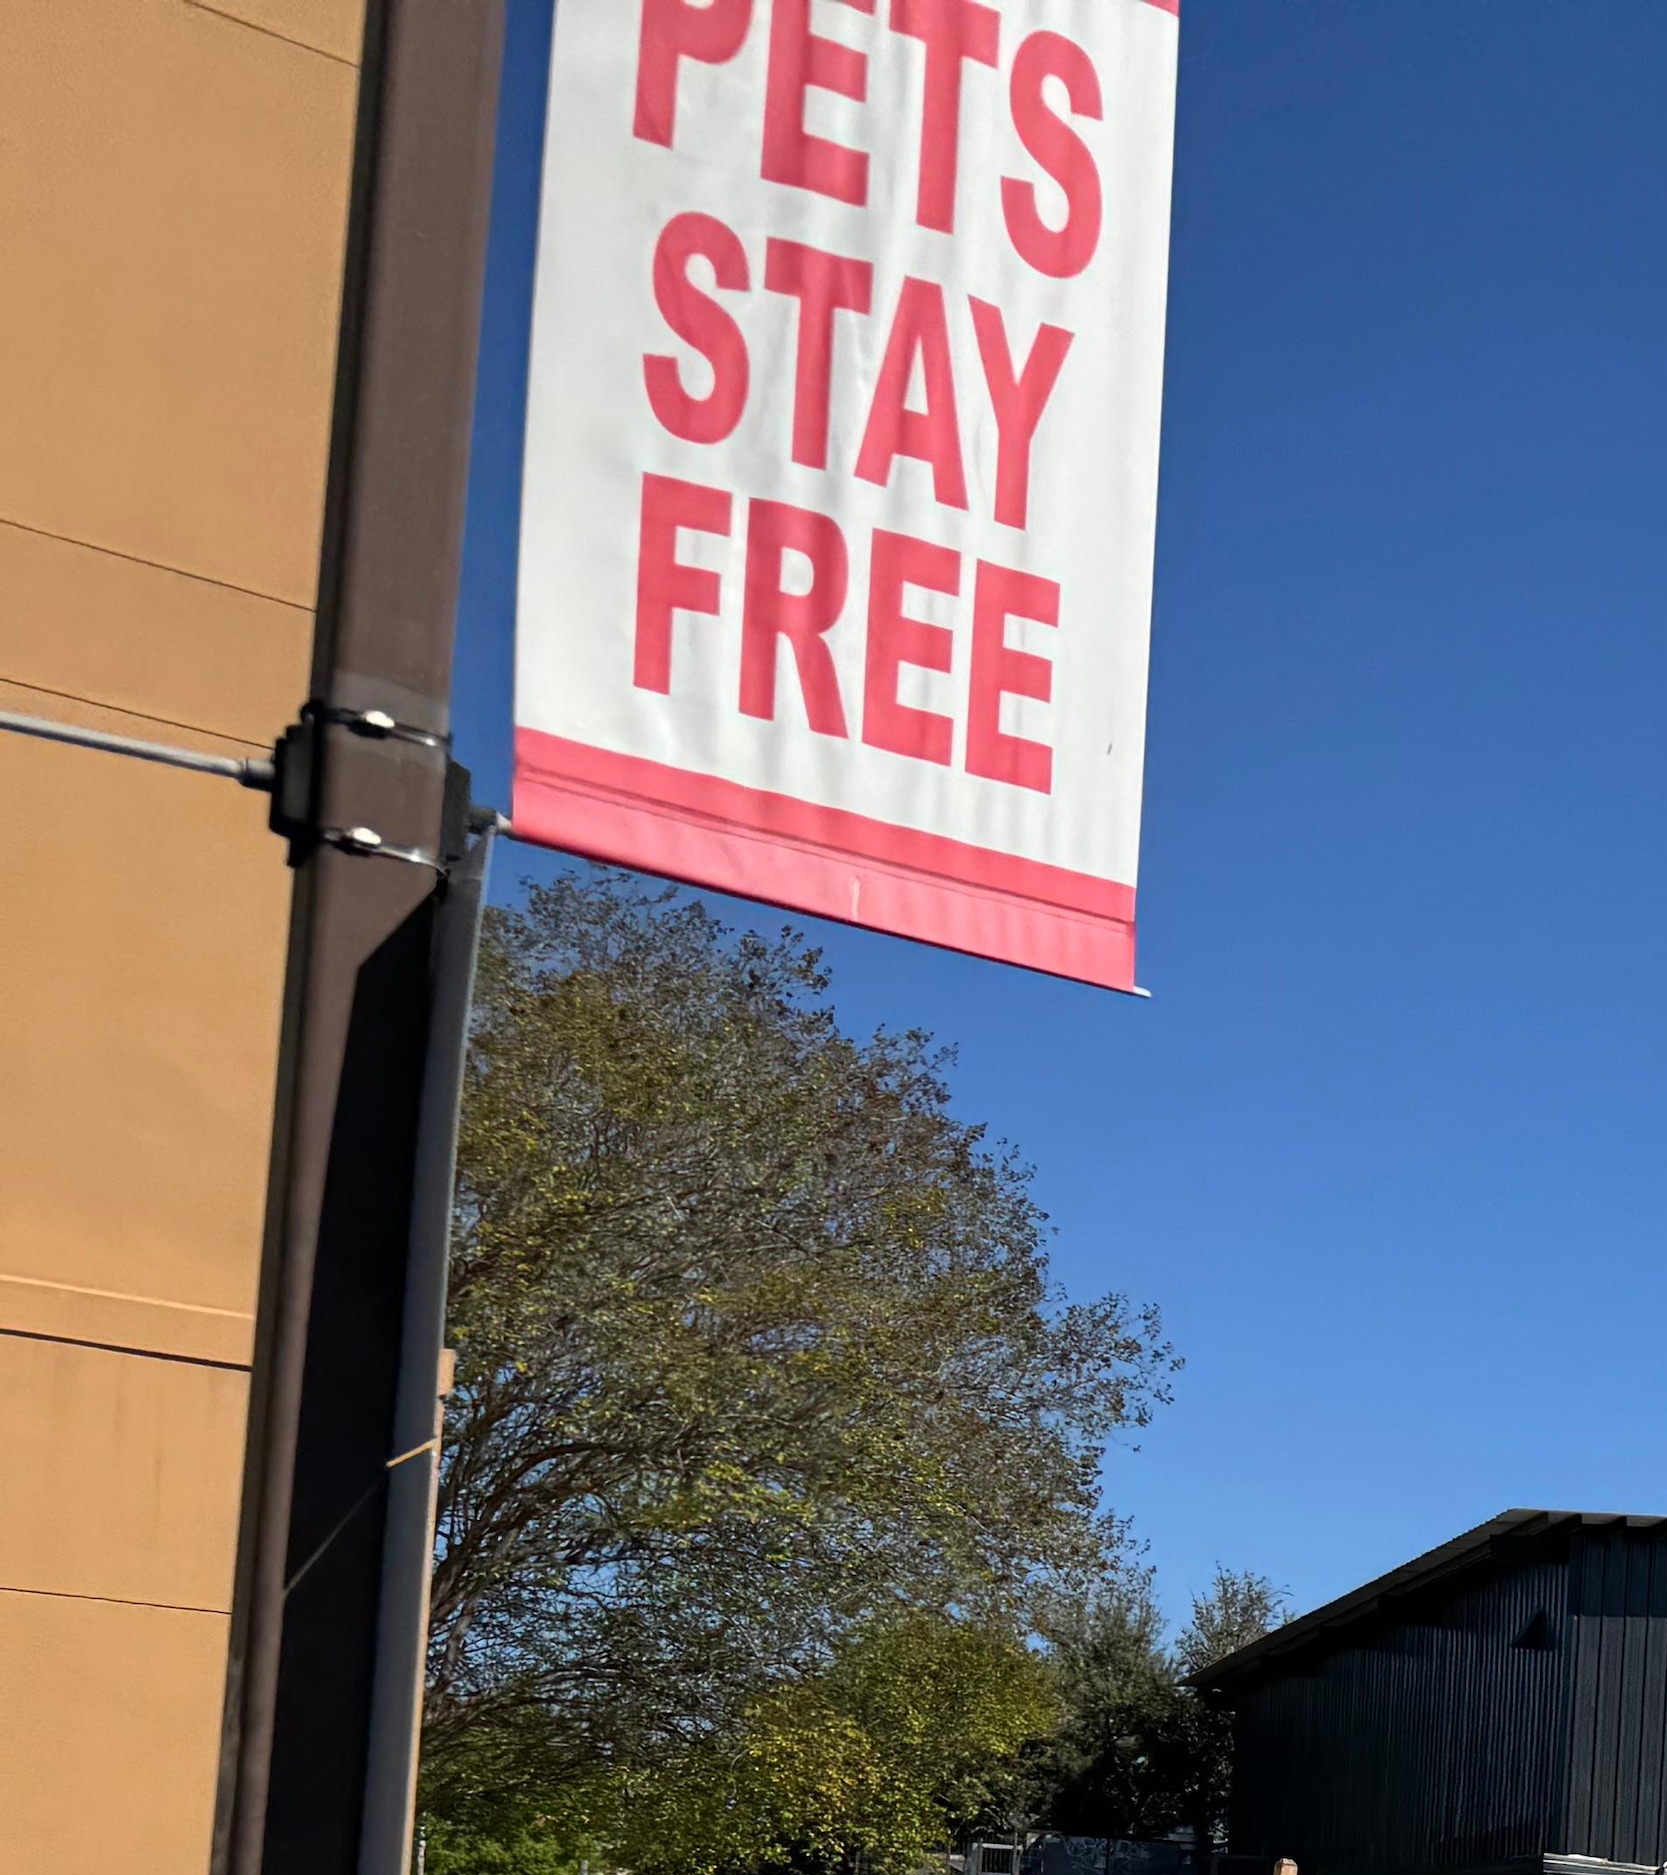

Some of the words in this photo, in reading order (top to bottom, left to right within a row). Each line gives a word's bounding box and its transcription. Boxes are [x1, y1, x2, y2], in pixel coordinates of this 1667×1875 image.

[633, 0, 1104, 279] PETS
[642, 211, 1075, 532] STAY
[632, 471, 1061, 796] FREE
